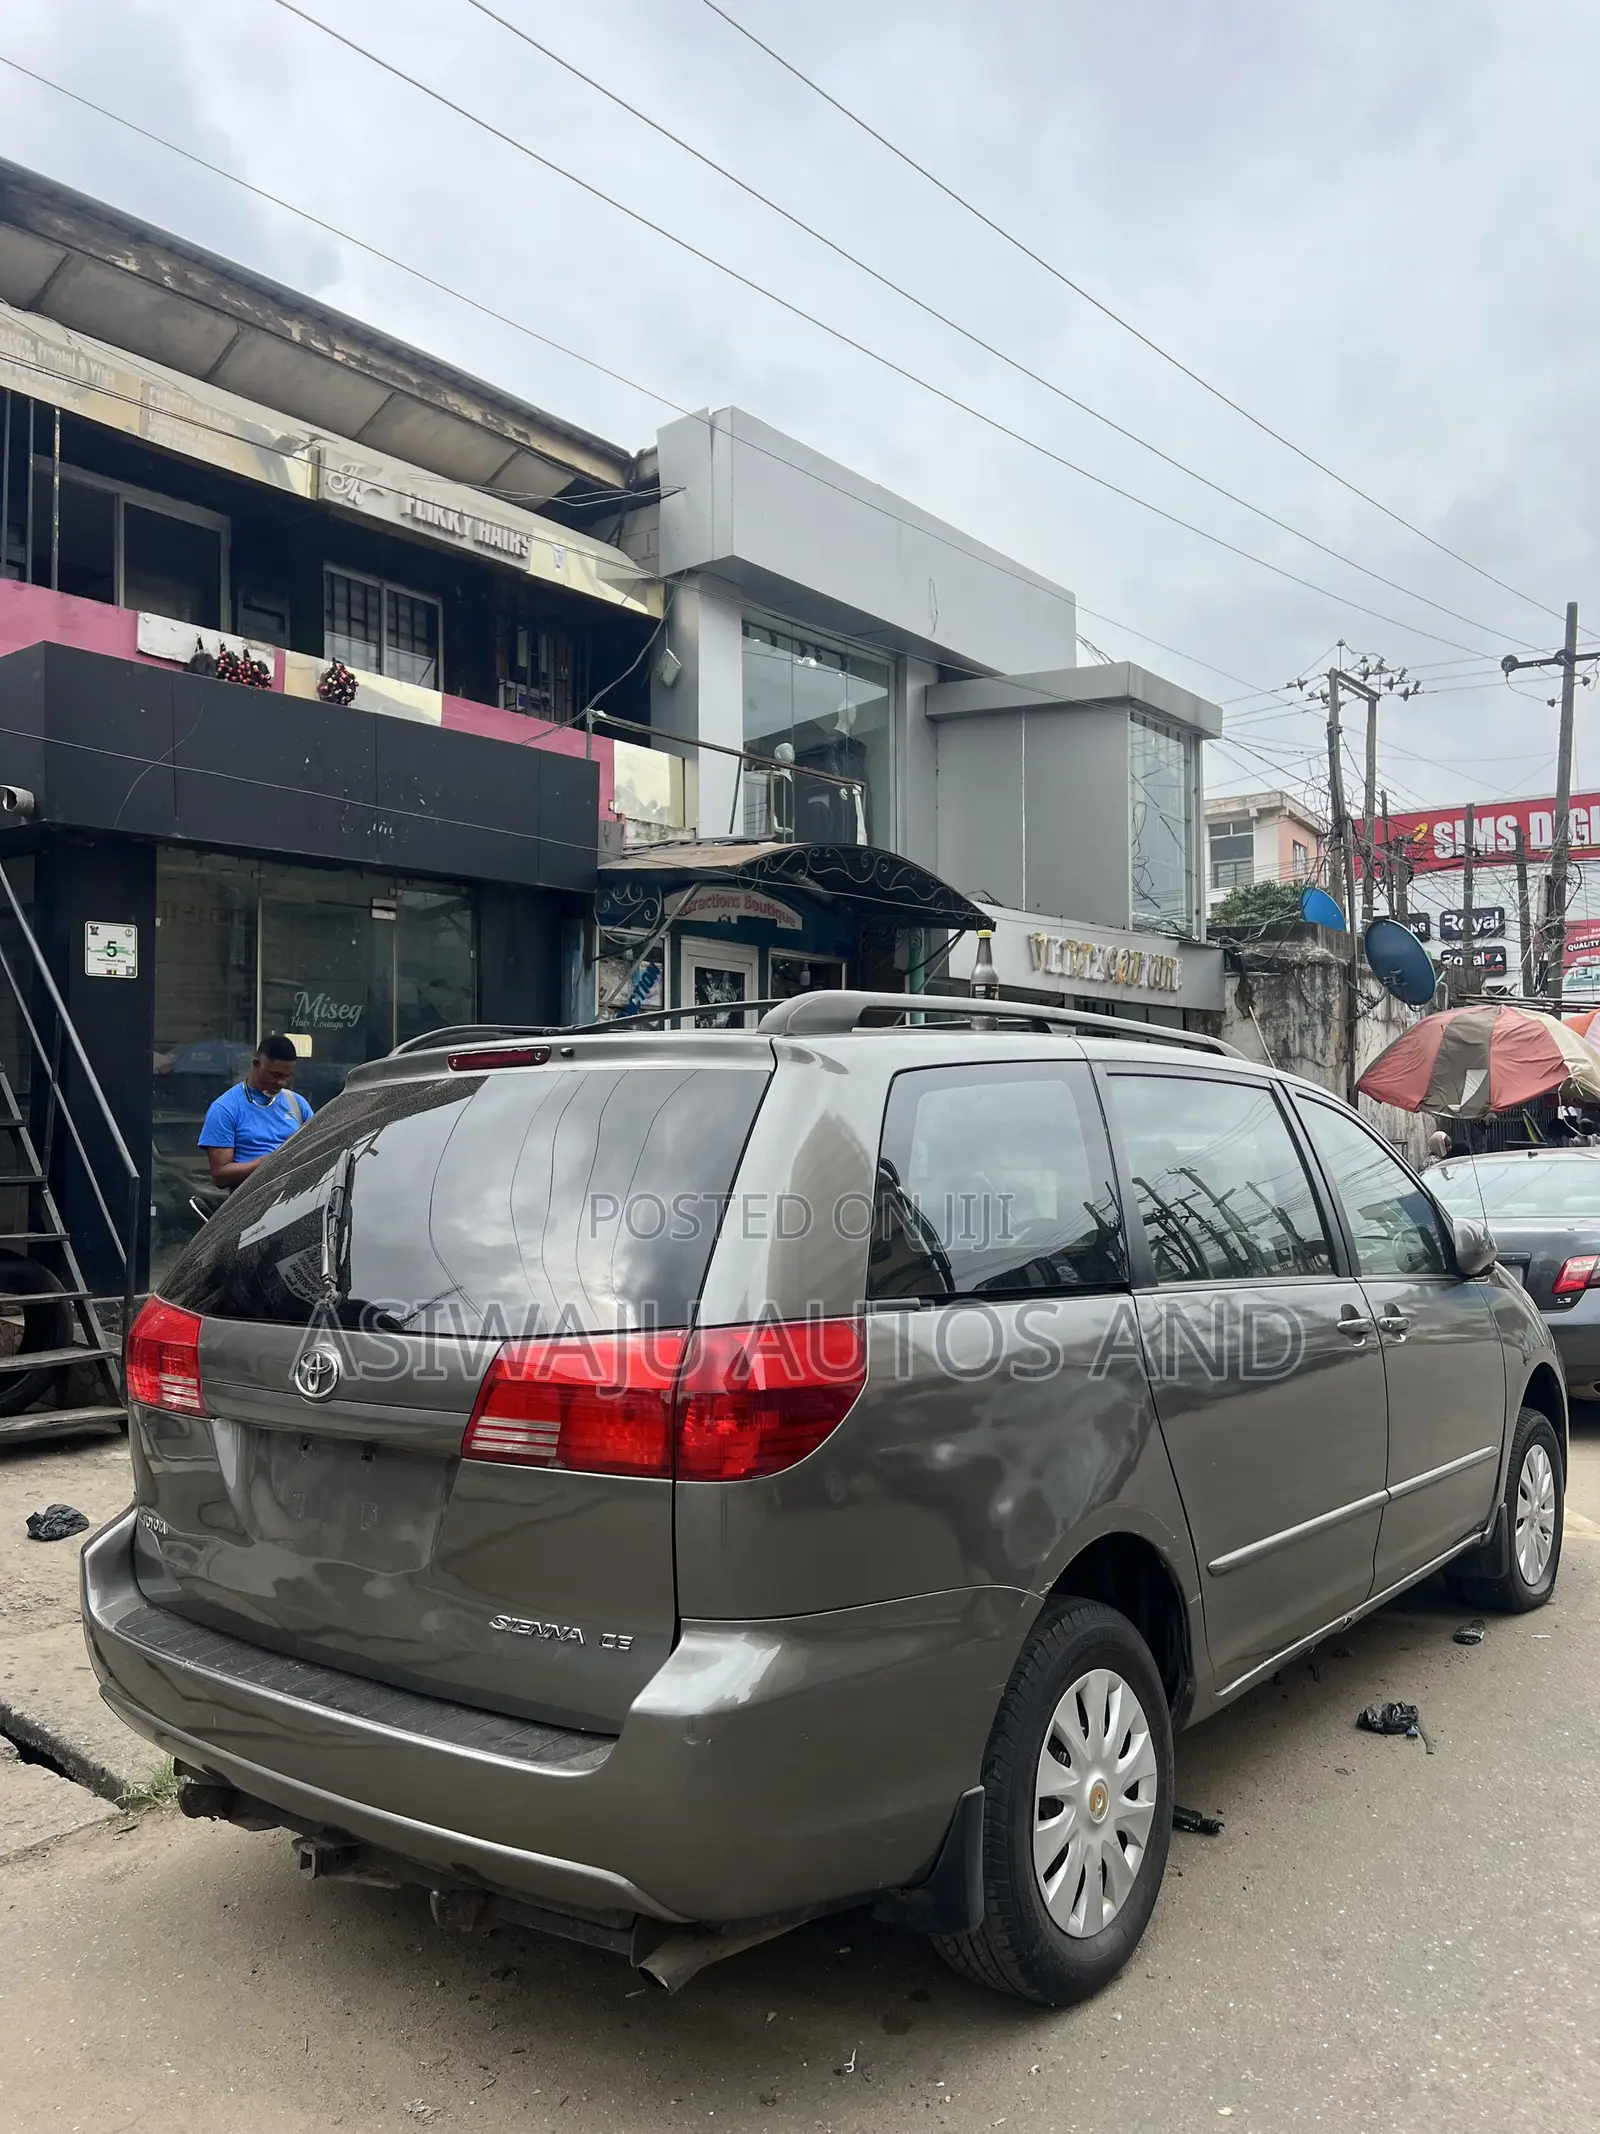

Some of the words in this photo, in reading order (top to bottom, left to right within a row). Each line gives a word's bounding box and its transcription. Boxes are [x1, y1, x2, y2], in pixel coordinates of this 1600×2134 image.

[1433, 814, 1518, 858] SIMS
[1529, 805, 1600, 851] DGI
[743, 894, 796, 927] Boutique
[106, 940, 118, 957] 5
[1567, 939, 1600, 952] QUALITY
[1443, 951, 1486, 966] Roal
[488, 1614, 586, 1645] SIENNA
[598, 1632, 635, 1651] CE
